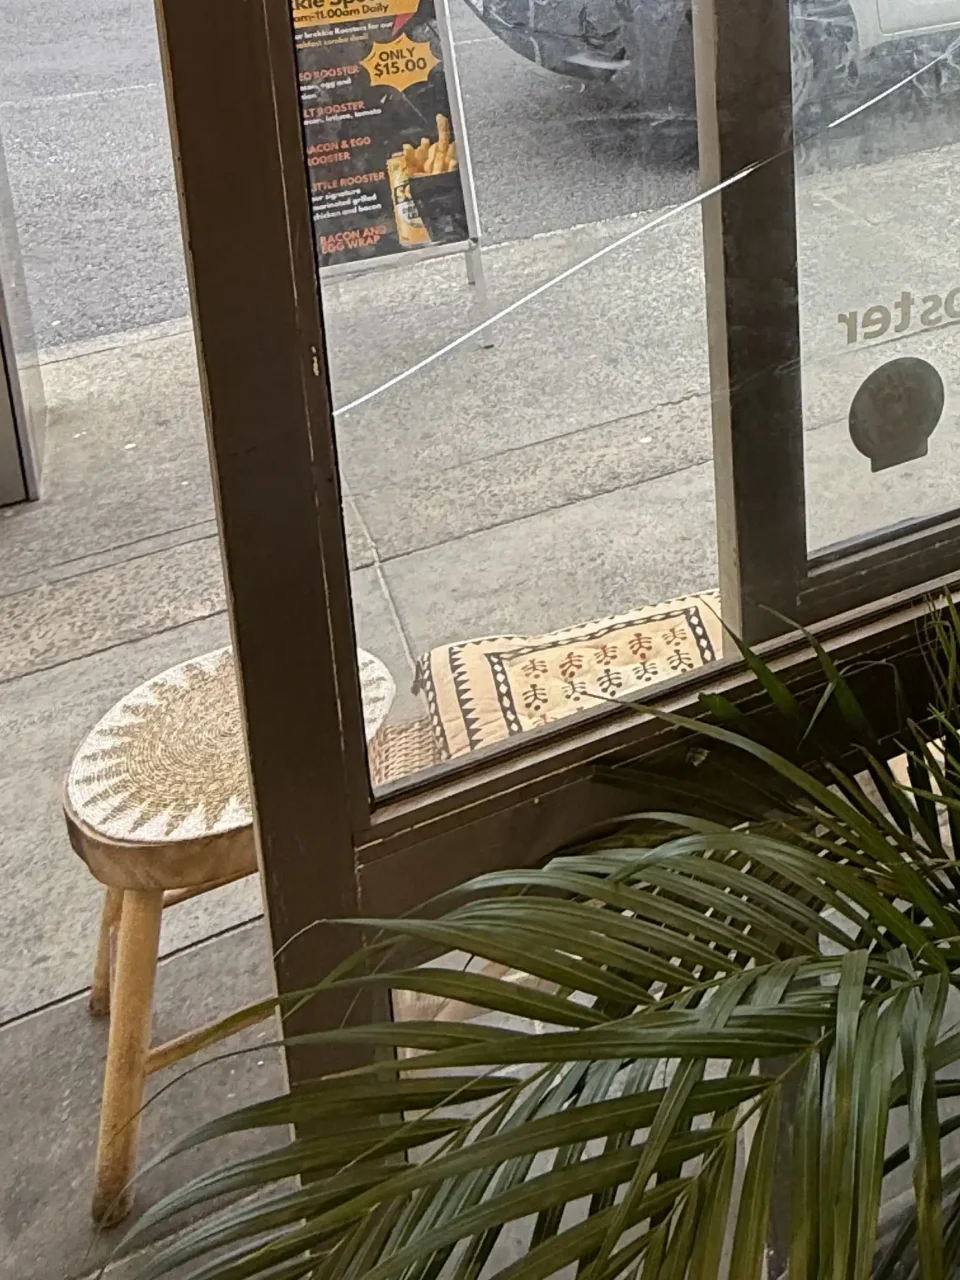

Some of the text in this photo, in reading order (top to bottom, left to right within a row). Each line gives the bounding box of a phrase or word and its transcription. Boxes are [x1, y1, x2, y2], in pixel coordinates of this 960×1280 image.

[362, 3, 389, 14] Daily
[379, 47, 416, 62] ONLY
[313, 64, 360, 80] ROOSTER
[374, 57, 427, 78] $15.00
[316, 100, 366, 117] ROOSTER
[340, 140, 349, 149] &
[340, 171, 386, 187] ROOSTER
[341, 206, 357, 216] and
[358, 203, 382, 213] bacon
[320, 229, 360, 244] BACON
[321, 235, 381, 254] EGG WRAP
